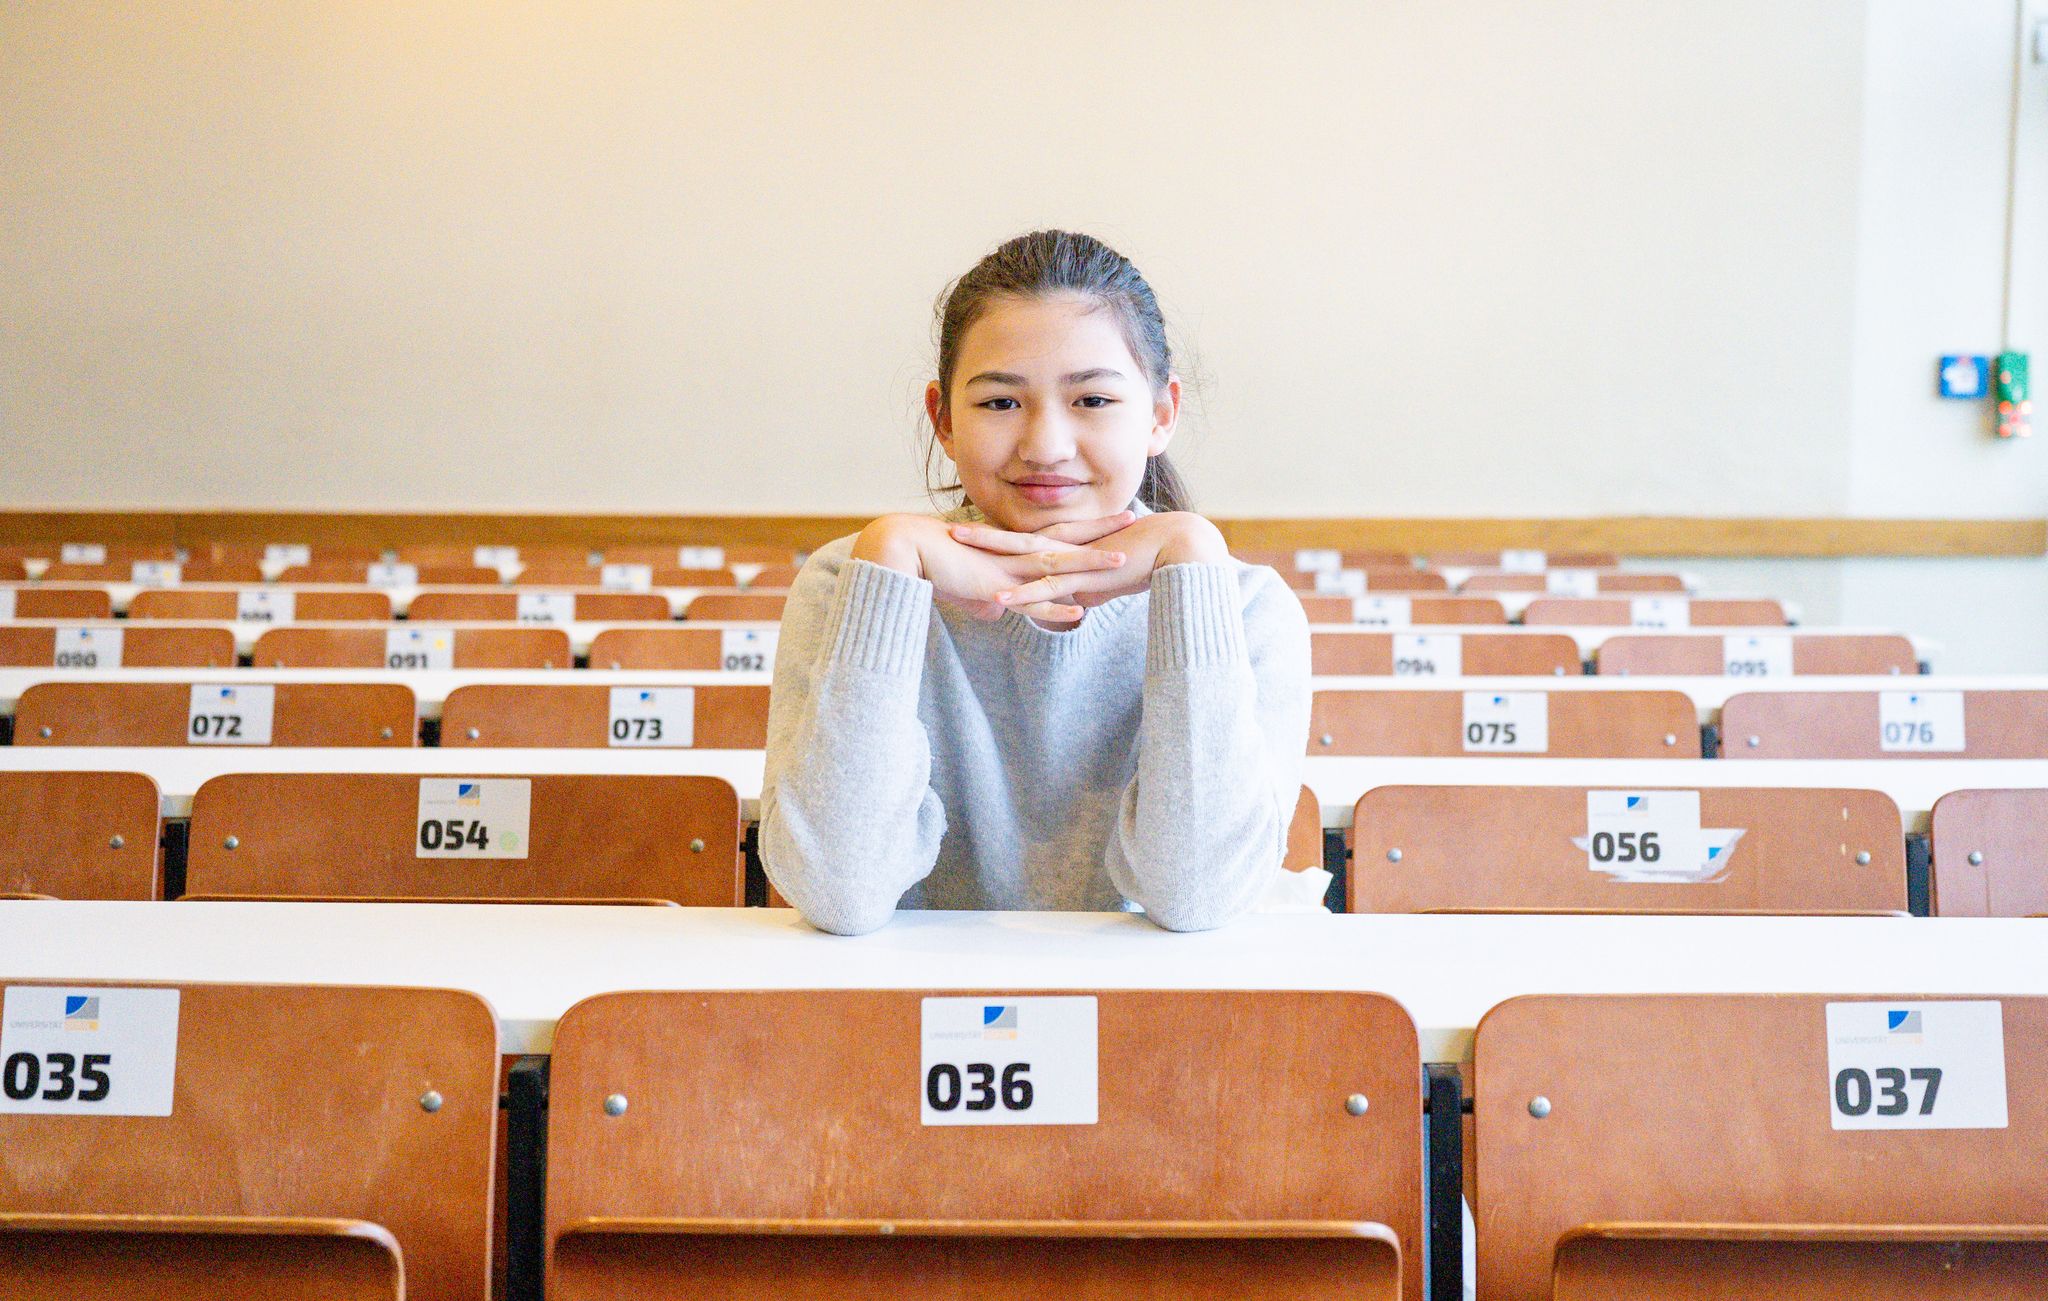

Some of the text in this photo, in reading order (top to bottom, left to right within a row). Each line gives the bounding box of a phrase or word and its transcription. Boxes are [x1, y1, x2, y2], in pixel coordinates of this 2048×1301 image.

[192, 715, 242, 737] 072
[613, 718, 662, 740] 073
[1467, 723, 1517, 744] 075
[1885, 722, 1934, 743] 076
[420, 819, 489, 850] 054
[1592, 832, 1660, 862] 056
[3, 1052, 111, 1101] 035
[927, 1062, 1034, 1112] 036
[1835, 1067, 1943, 1116] 037
